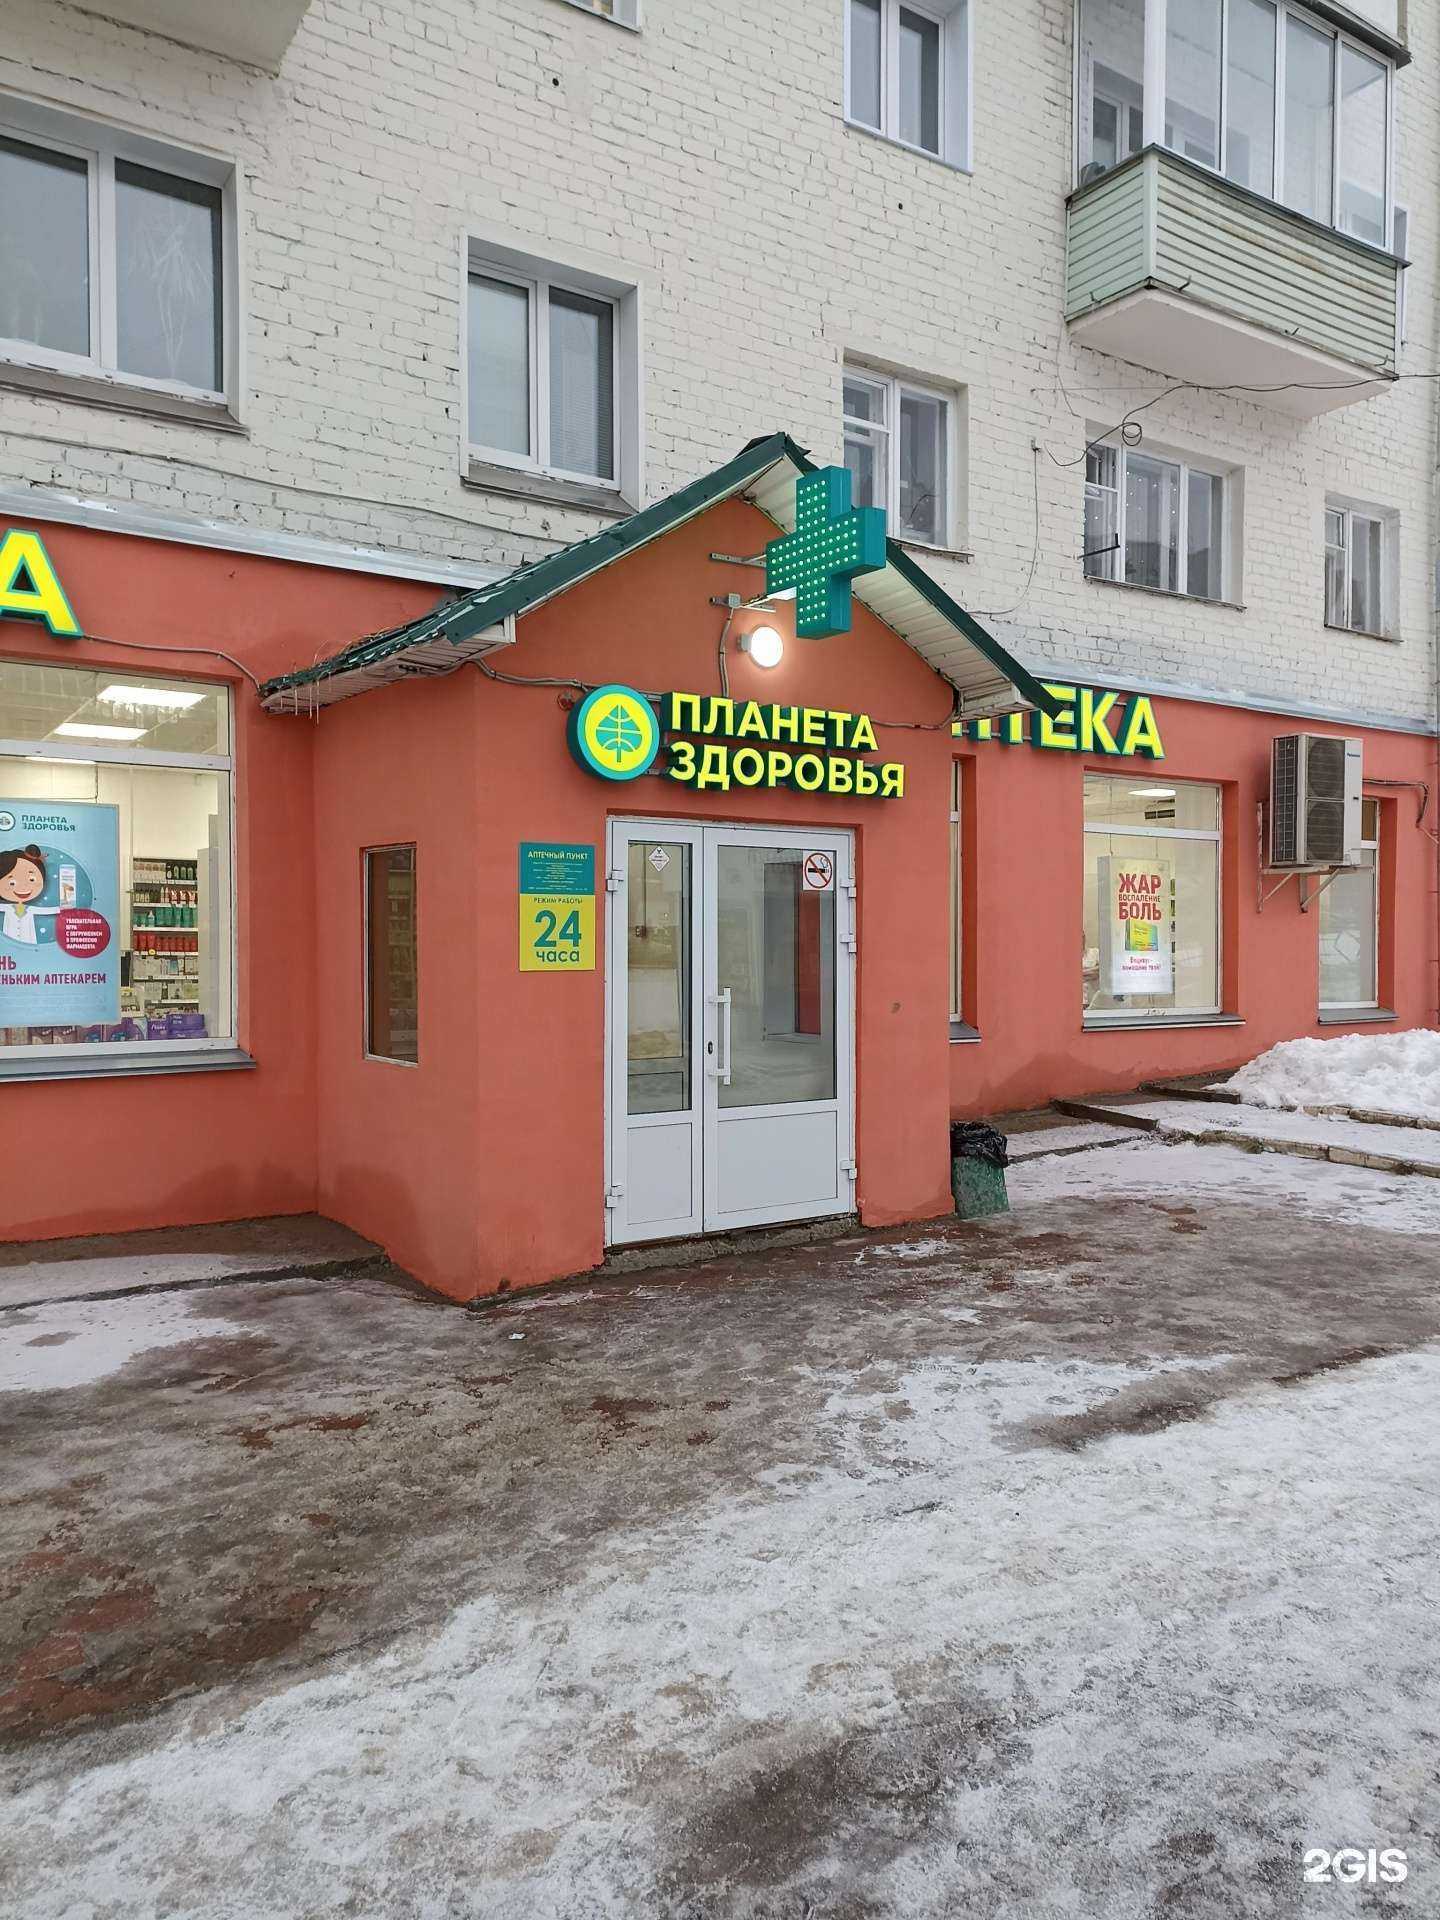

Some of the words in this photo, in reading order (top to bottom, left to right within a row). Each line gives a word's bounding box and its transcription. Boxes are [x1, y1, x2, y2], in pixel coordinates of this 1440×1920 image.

[671, 691, 880, 751] ПЛАНЕТА
[668, 741, 906, 798] ЗДОРОВЬЯ
[21, 814, 68, 824] ПЛАНЕТА
[22, 822, 76, 832] ЗДОРОВЬЯ
[527, 850, 565, 859] АПТЕЧНЫЙ
[566, 852, 588, 860] ПУНКТ
[1118, 872, 1162, 895] ЖАР
[1118, 893, 1161, 903] ВОСПАЛЕНИЕ
[1118, 902, 1162, 920] БОЛЬ
[534, 909, 582, 948] 24
[536, 950, 580, 963] часа
[43, 973, 107, 985] АПТЕКАРЕМ
